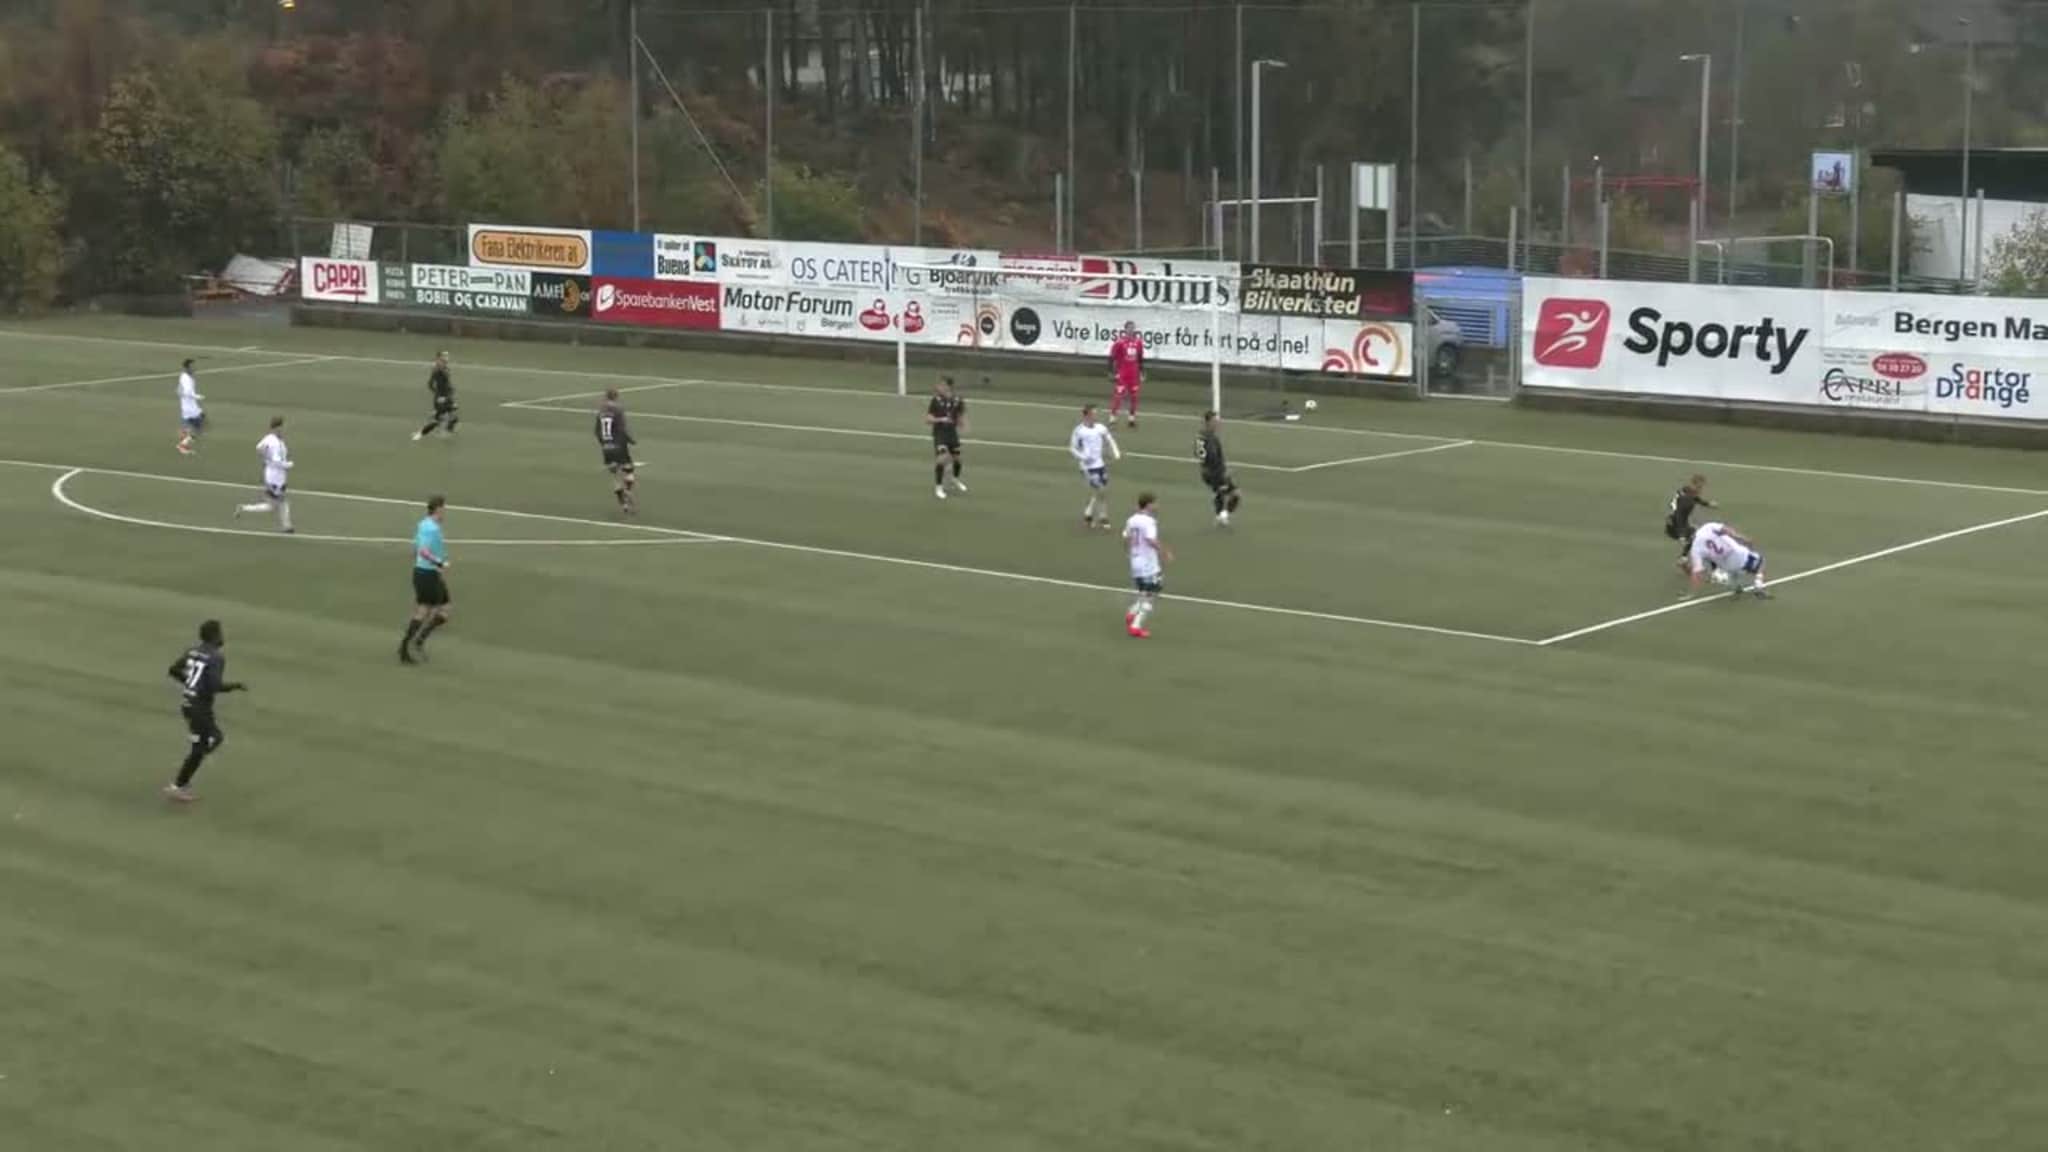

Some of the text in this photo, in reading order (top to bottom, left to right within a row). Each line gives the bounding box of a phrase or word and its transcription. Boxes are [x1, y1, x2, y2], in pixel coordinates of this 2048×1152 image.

[313, 263, 367, 293] CAPRI
[417, 267, 469, 288] PETER
[494, 272, 526, 292] PAN
[658, 254, 690, 275] Buena
[792, 257, 817, 280] OS
[1112, 260, 1230, 306] Bohus
[416, 290, 527, 312] BOBIL OG CARAVAN
[1052, 319, 1090, 341] Våre
[1095, 323, 1170, 349] løsnnger
[1176, 326, 1198, 346] får
[1204, 329, 1232, 349] frt
[1237, 332, 1260, 353] på
[1623, 307, 1809, 374] Sporty
[1894, 311, 1997, 342] Bergen
[1952, 363, 2031, 388] Sartor
[1936, 377, 2030, 408] Drange
